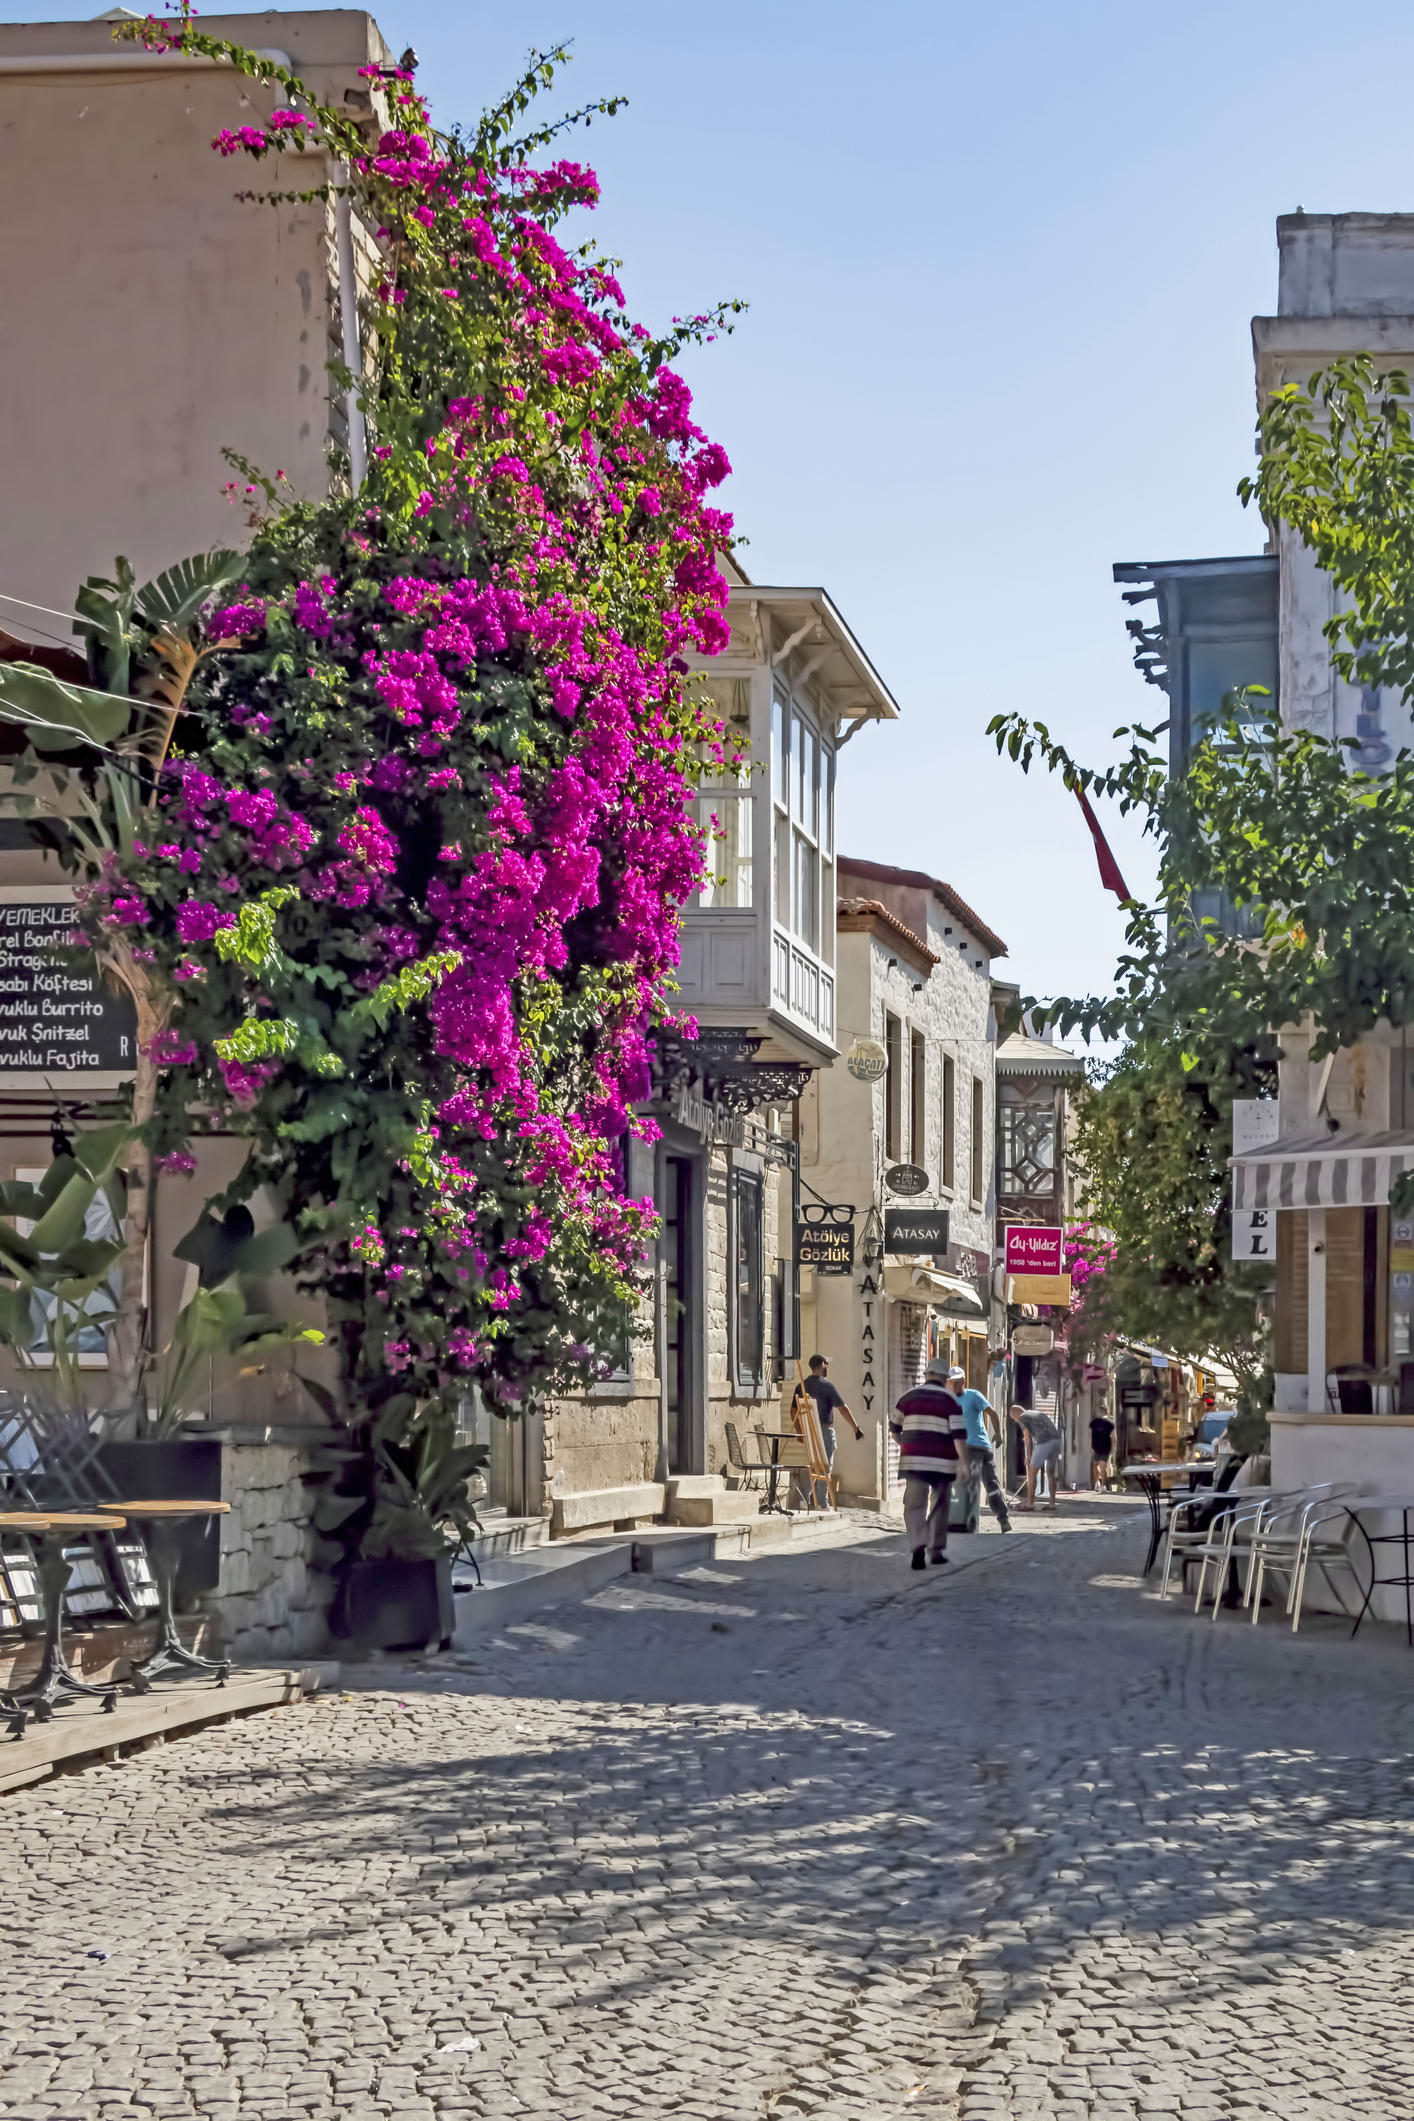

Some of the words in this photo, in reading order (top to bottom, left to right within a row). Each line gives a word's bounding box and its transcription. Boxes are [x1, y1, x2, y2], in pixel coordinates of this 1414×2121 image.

[33, 974, 93, 995] Köftesi
[42, 998, 104, 1016] Burrito
[31, 1023, 90, 1043] Şnitzel
[46, 1050, 100, 1070] Fajita
[801, 1229, 850, 1247] Atölye
[893, 1226, 940, 1240] ATASAY
[800, 1247, 851, 1262] Gözlük
